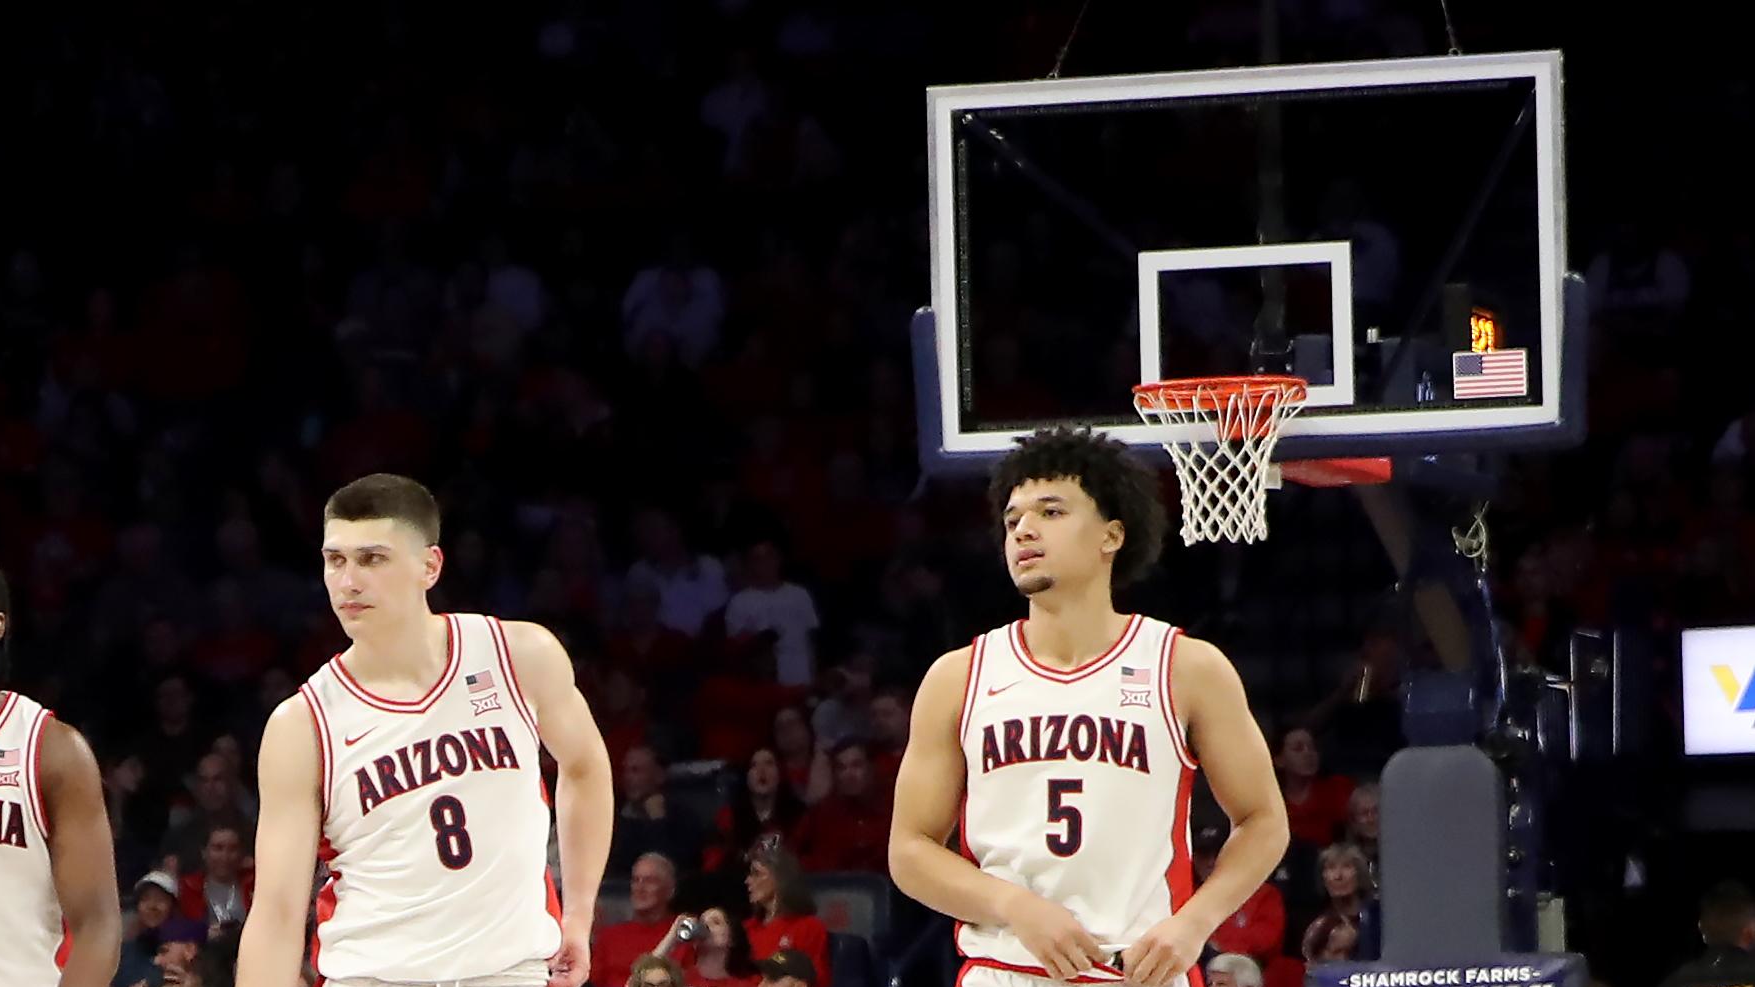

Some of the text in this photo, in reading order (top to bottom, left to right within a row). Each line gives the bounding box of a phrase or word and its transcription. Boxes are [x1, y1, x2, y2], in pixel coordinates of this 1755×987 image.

[354, 727, 520, 817] ARIZONA
[982, 714, 1150, 774] ARIZONA
[429, 795, 473, 870] 8
[1045, 778, 1083, 857] 5
[1465, 966, 1532, 984] FARMS
